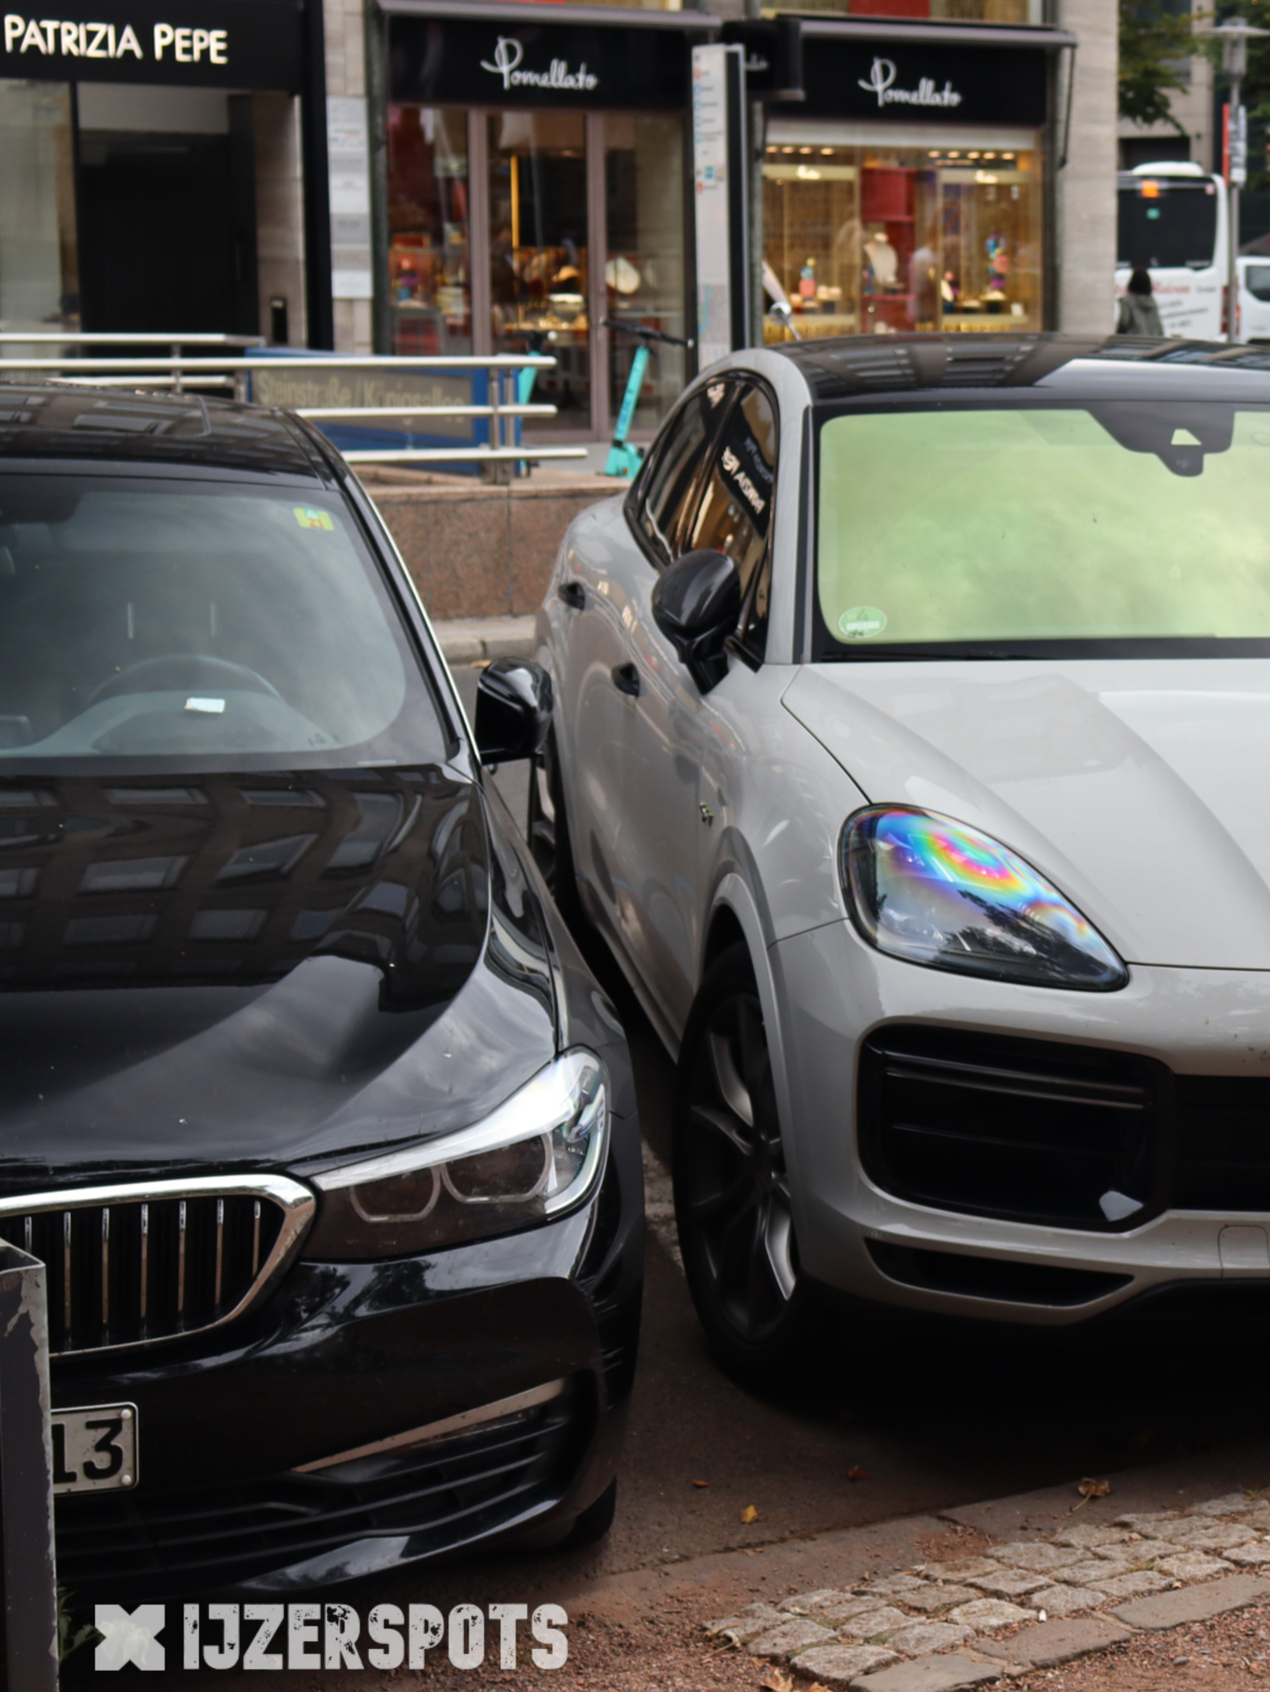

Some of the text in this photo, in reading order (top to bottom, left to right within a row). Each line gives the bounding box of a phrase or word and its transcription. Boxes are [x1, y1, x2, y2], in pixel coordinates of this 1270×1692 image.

[4, 14, 228, 65] PATRIZIA PEPE
[480, 36, 598, 90] Pomellato
[858, 56, 962, 107] Pomellato
